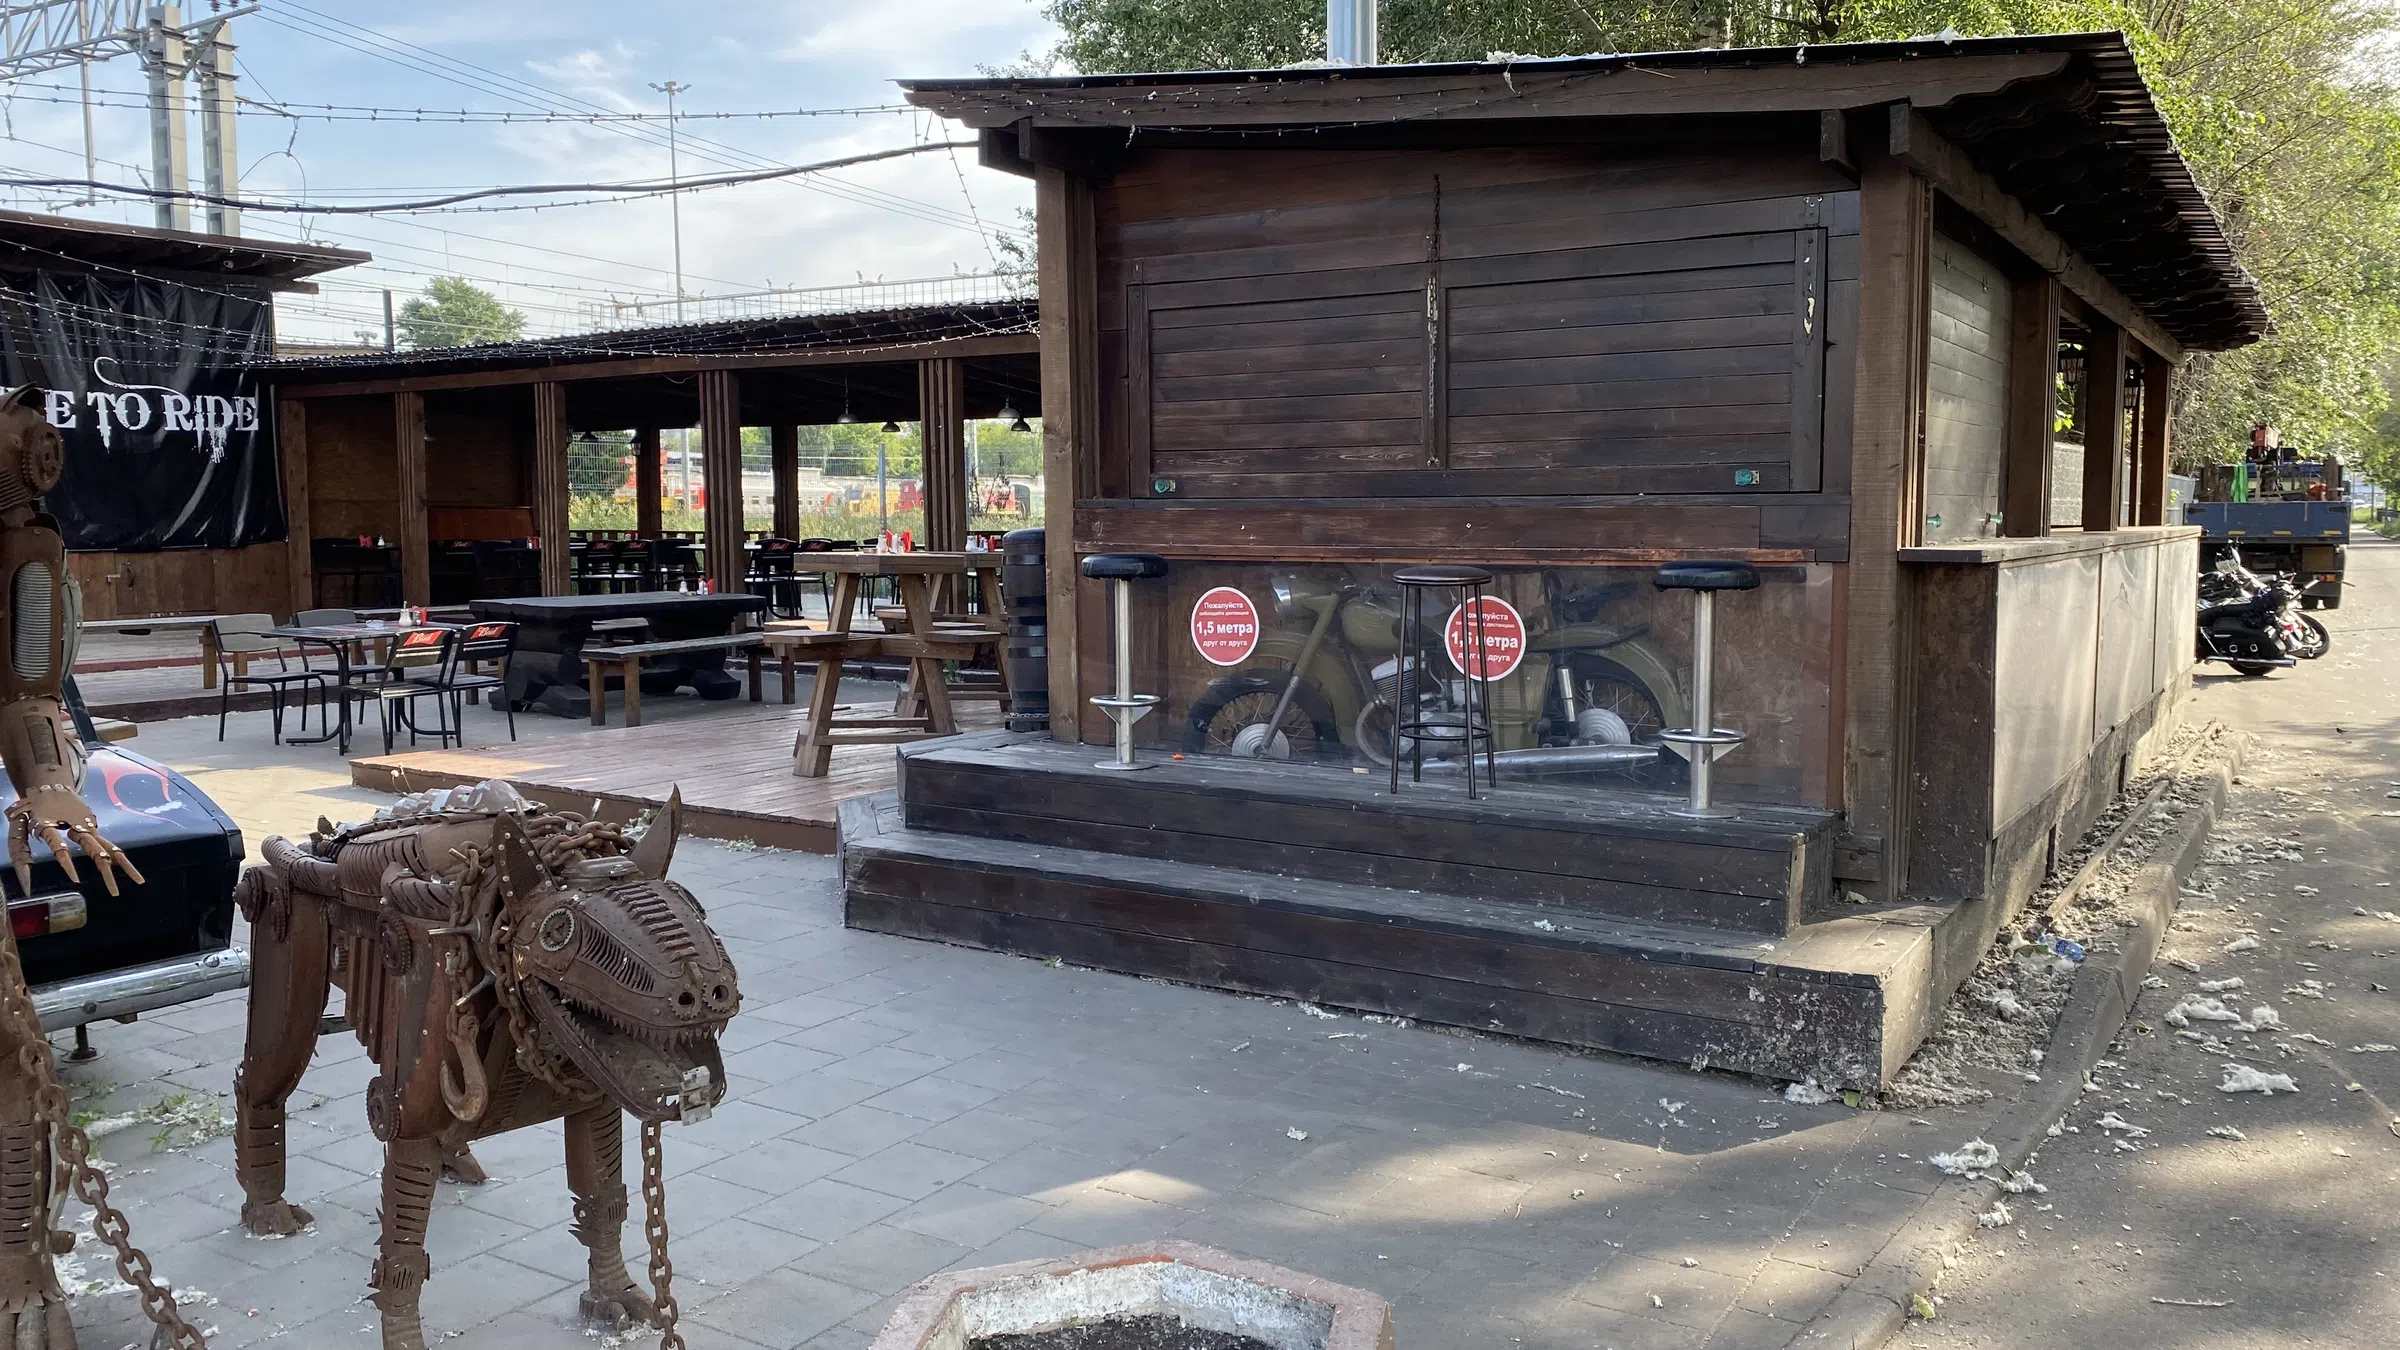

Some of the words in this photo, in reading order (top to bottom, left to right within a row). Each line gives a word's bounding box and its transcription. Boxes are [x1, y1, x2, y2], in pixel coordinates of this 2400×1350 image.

[87, 391, 151, 448] TO
[161, 393, 259, 449] RIDE
[1204, 602, 1243, 610] Пожалуйста
[1196, 621, 1214, 636] 1,5
[1217, 623, 1253, 636] метра
